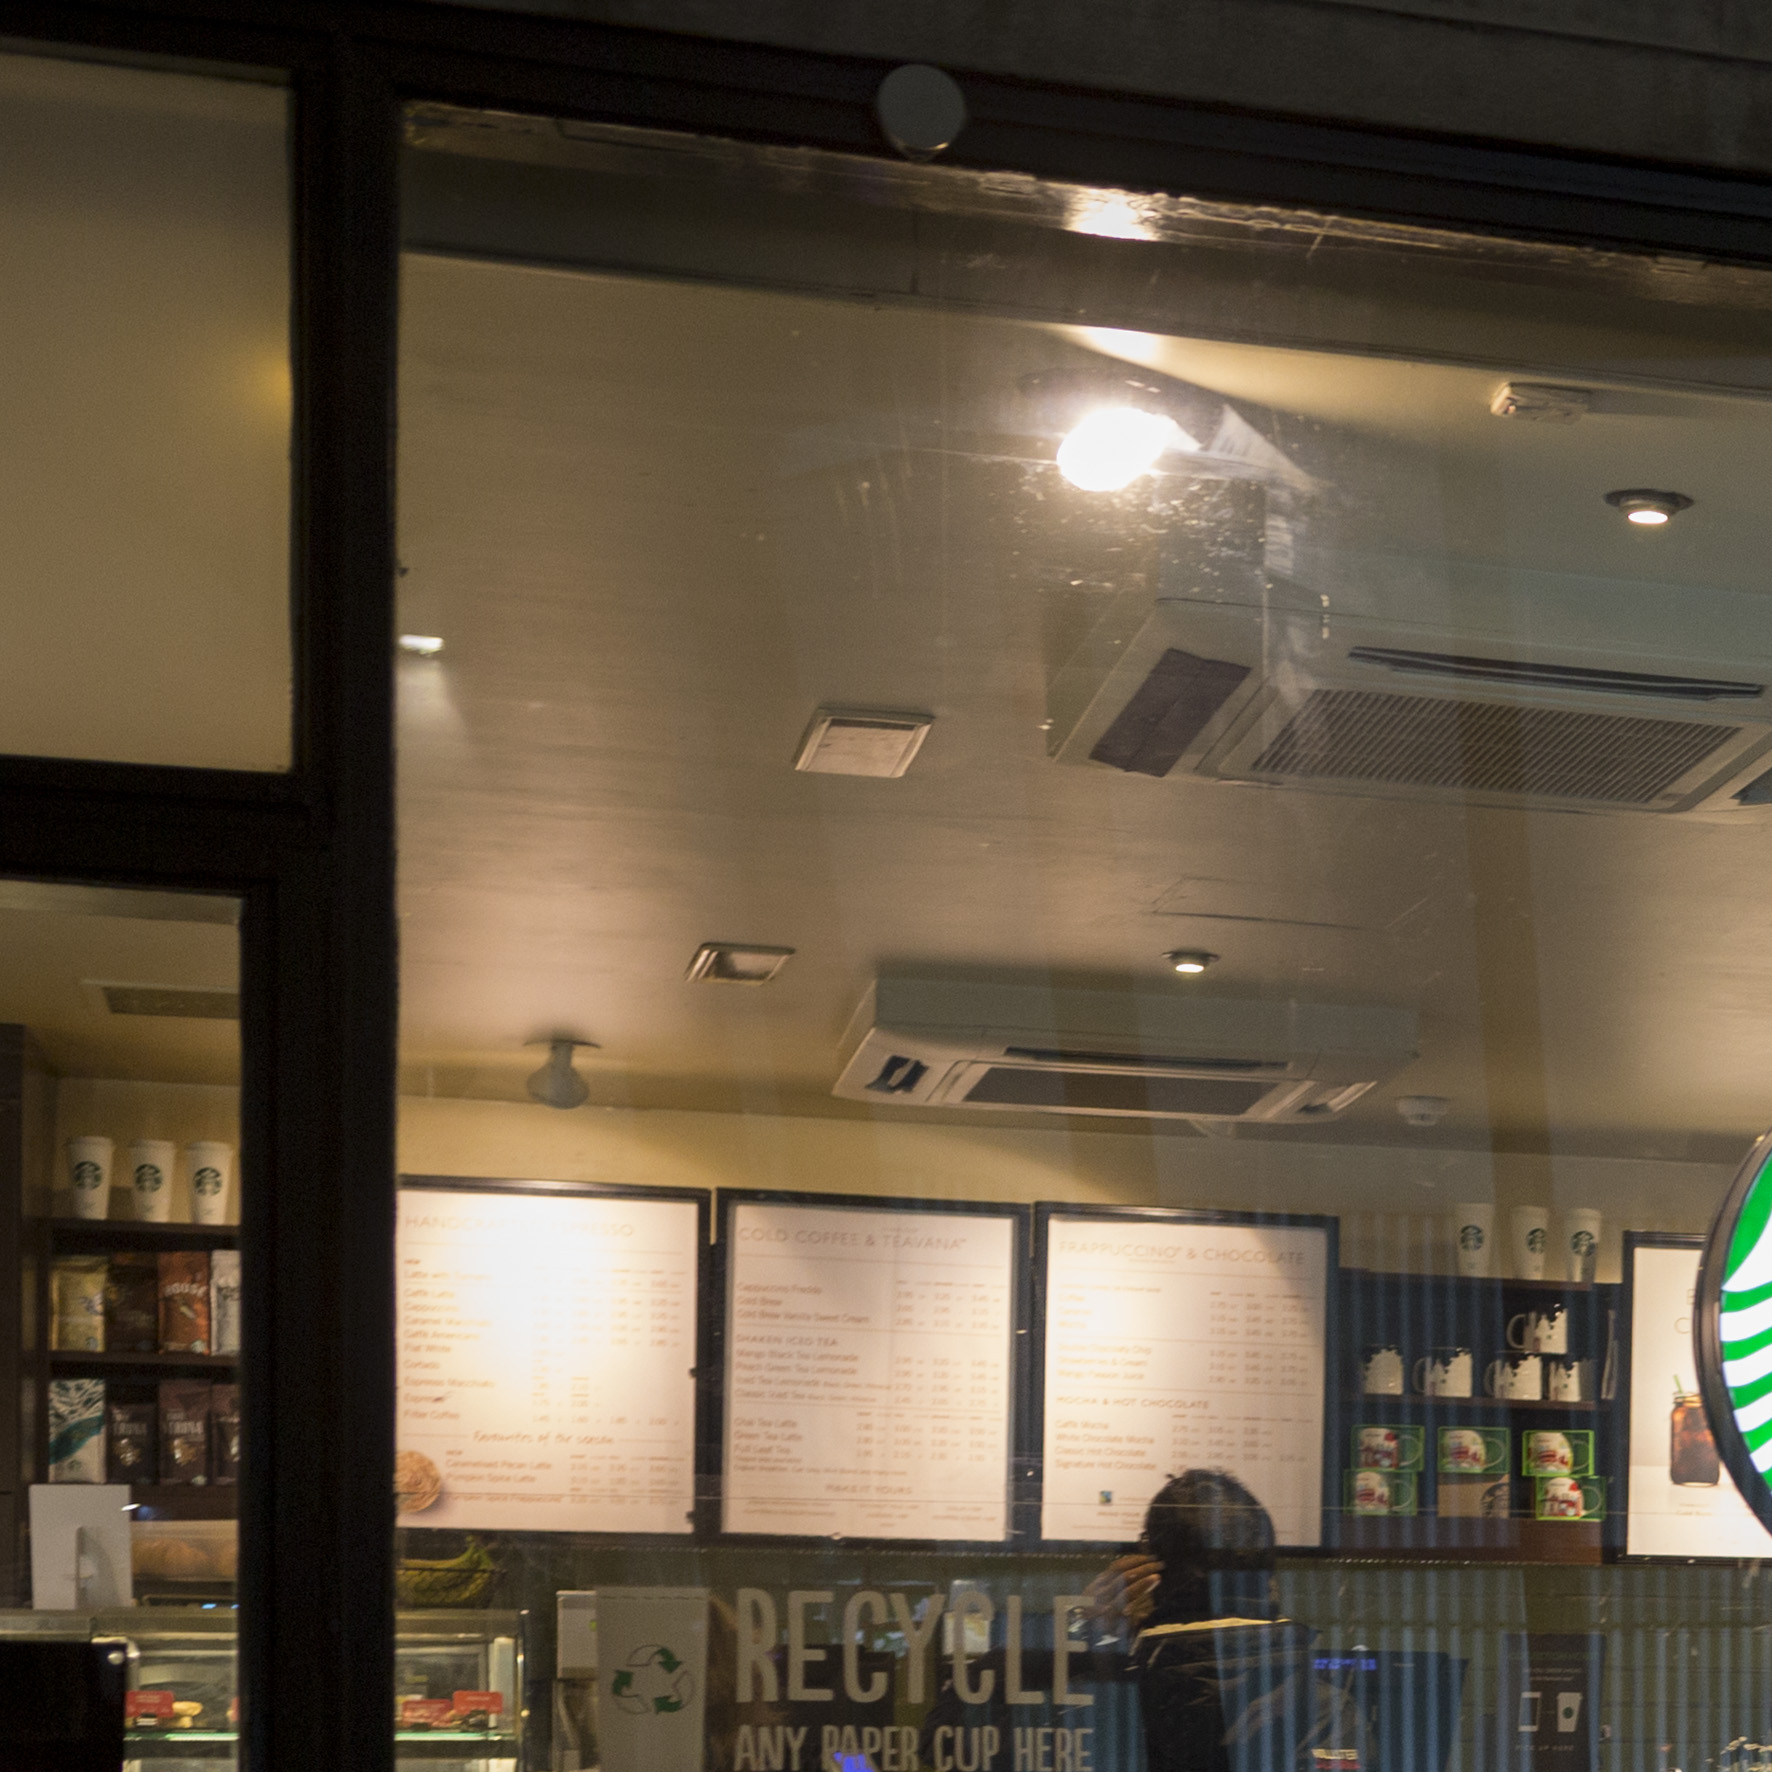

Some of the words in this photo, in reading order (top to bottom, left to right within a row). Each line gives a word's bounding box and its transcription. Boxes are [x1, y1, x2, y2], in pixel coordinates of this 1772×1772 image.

[739, 1228, 789, 1243] COLD
[795, 1230, 859, 1247] COFFEE
[735, 1587, 1096, 1707] RECYCLE
[733, 1726, 807, 1772] ANY
[820, 1725, 921, 1772] PAPER
[933, 1725, 1001, 1772] CUP
[1013, 1725, 1094, 1772] HERE
